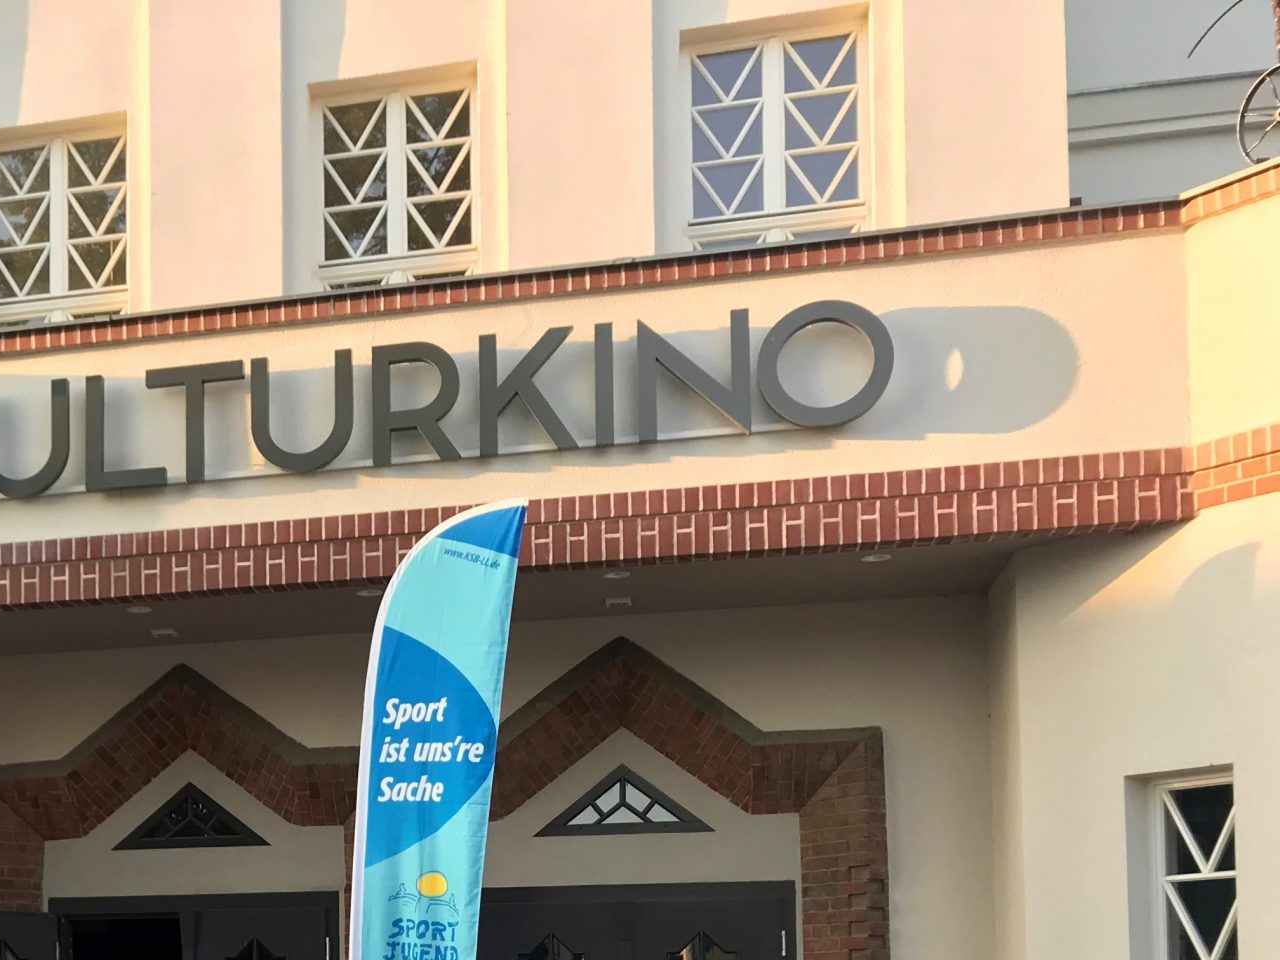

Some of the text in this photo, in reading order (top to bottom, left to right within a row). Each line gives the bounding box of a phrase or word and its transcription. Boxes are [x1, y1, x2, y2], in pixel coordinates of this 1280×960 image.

[382, 697, 447, 730] Sport
[379, 735, 484, 763] ist uns're
[377, 775, 444, 802] Sache
[388, 917, 459, 942] SPORT
